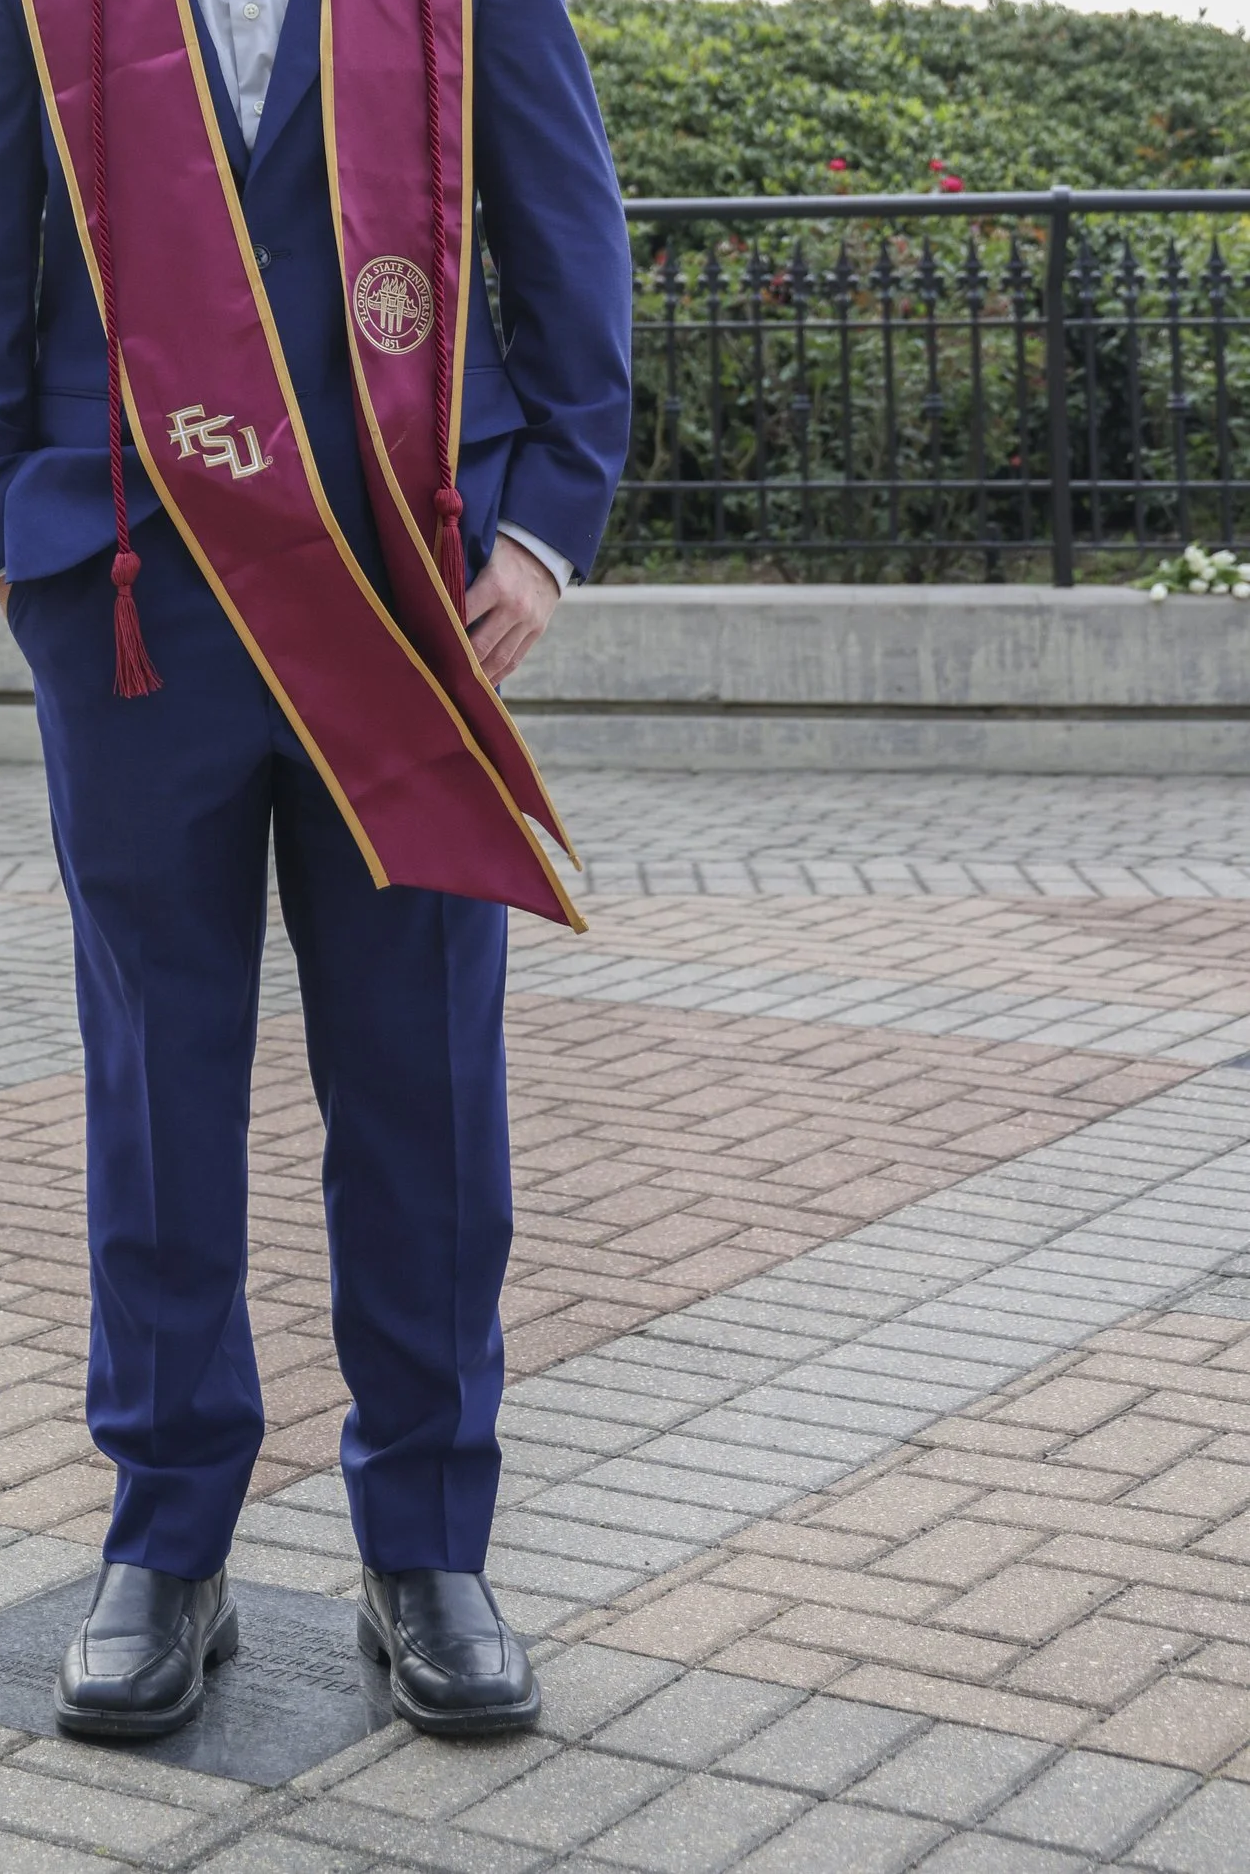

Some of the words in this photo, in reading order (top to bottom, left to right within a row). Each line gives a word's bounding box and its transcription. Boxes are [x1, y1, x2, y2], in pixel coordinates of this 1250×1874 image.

[356, 272, 374, 324] FLORIDA
[372, 262, 405, 275] STATE
[406, 268, 431, 337] UNIVERSITY
[381, 336, 401, 349] 1851
[166, 404, 268, 479] FSU
[230, 1658, 365, 1695] MMITTEE
[233, 1645, 347, 1675] QUERED
